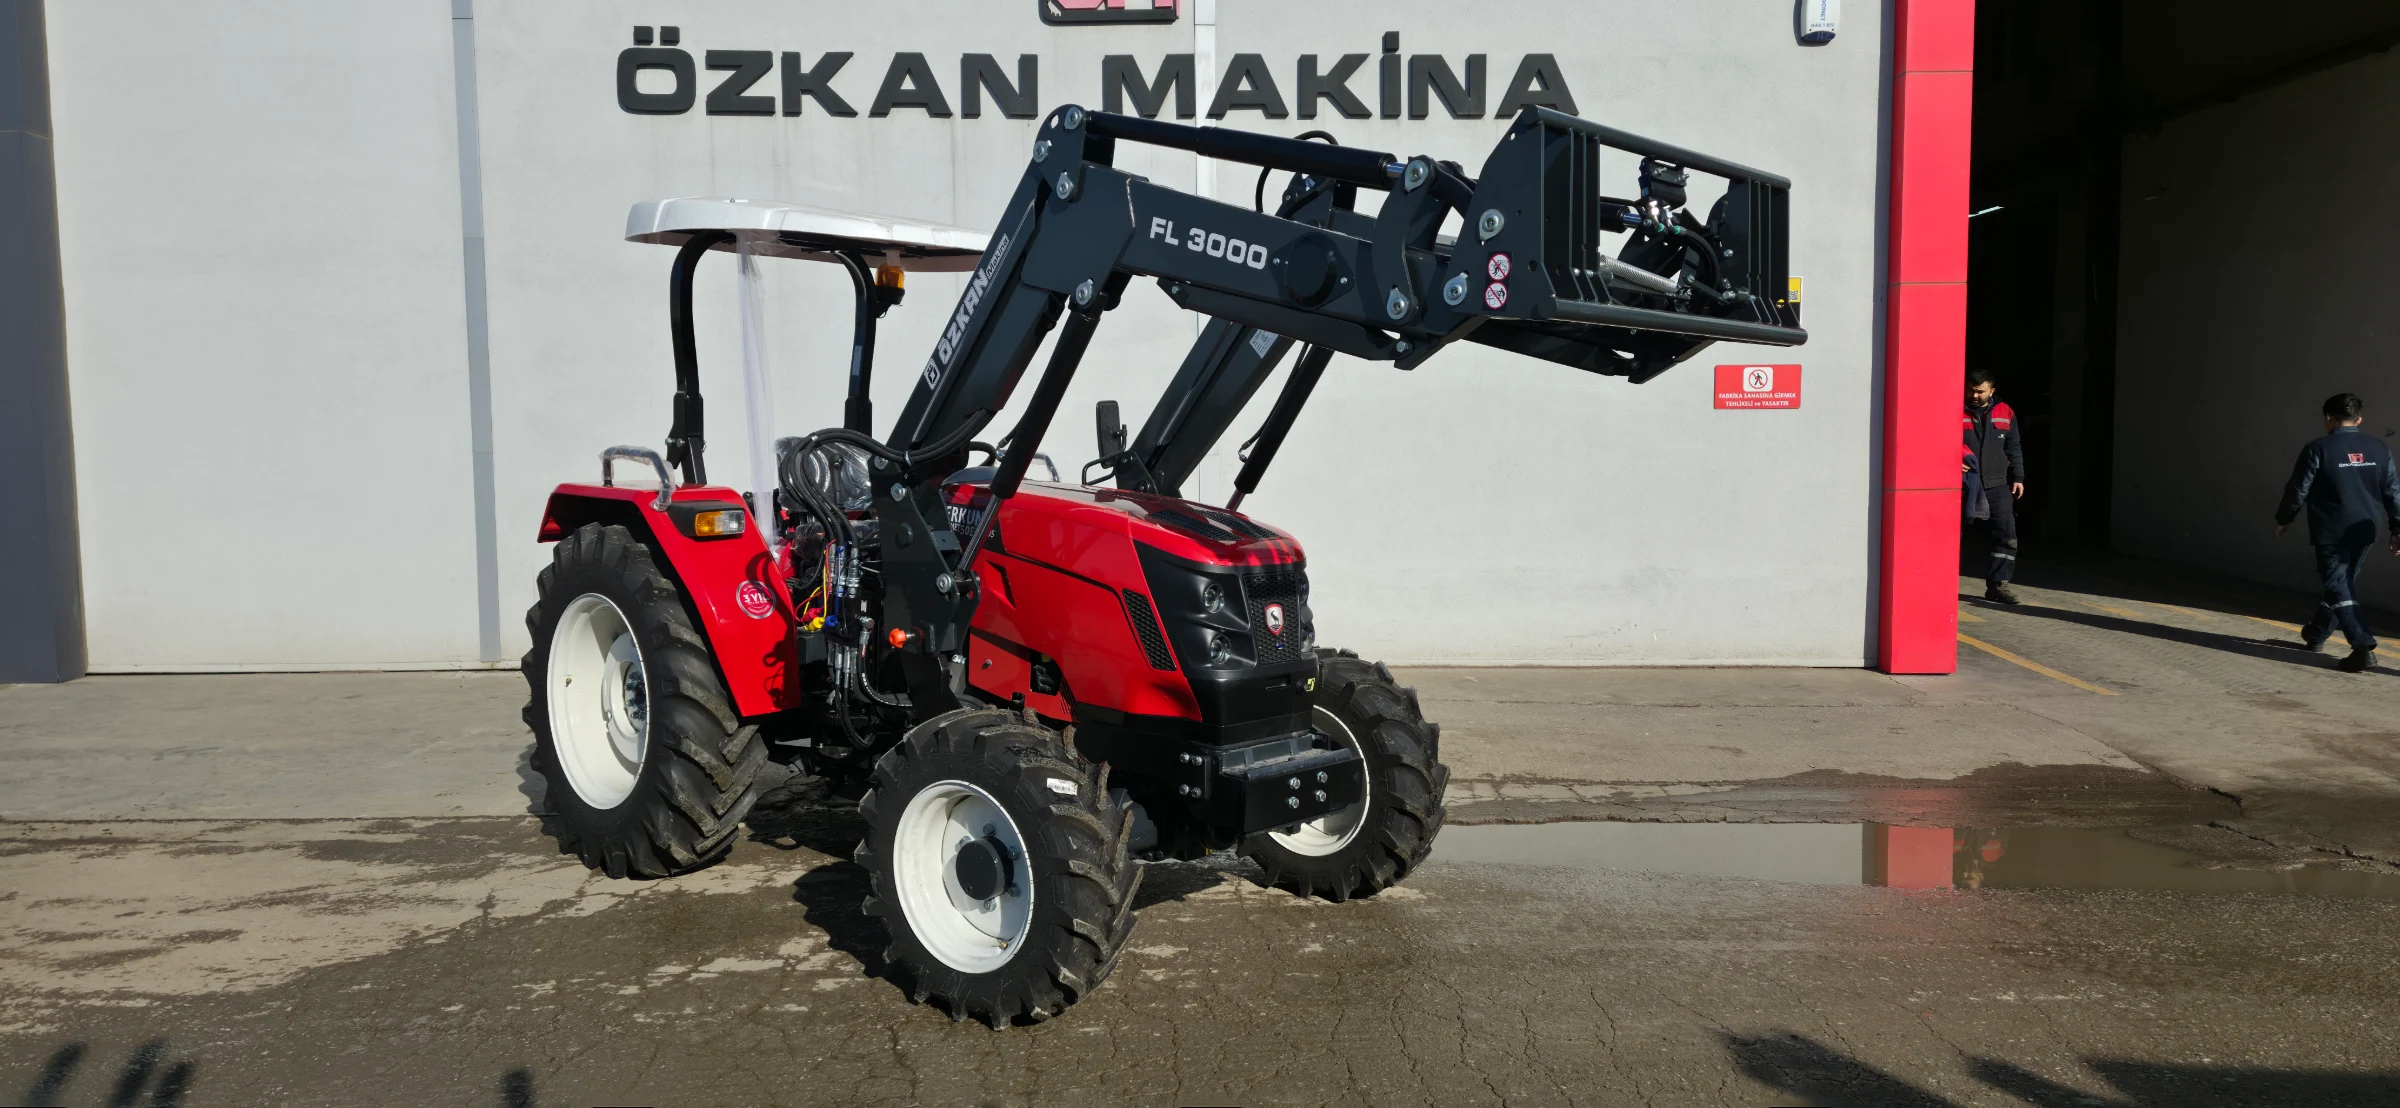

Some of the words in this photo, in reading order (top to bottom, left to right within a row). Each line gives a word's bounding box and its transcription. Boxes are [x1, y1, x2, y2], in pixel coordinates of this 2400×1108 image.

[616, 26, 1039, 119] ÖZKAN
[1102, 31, 1579, 119] MAKİNA
[1149, 216, 1180, 246] FL
[1187, 227, 1268, 270] 3000
[938, 267, 989, 365] ÖZKAN
[742, 594, 751, 603] 3
